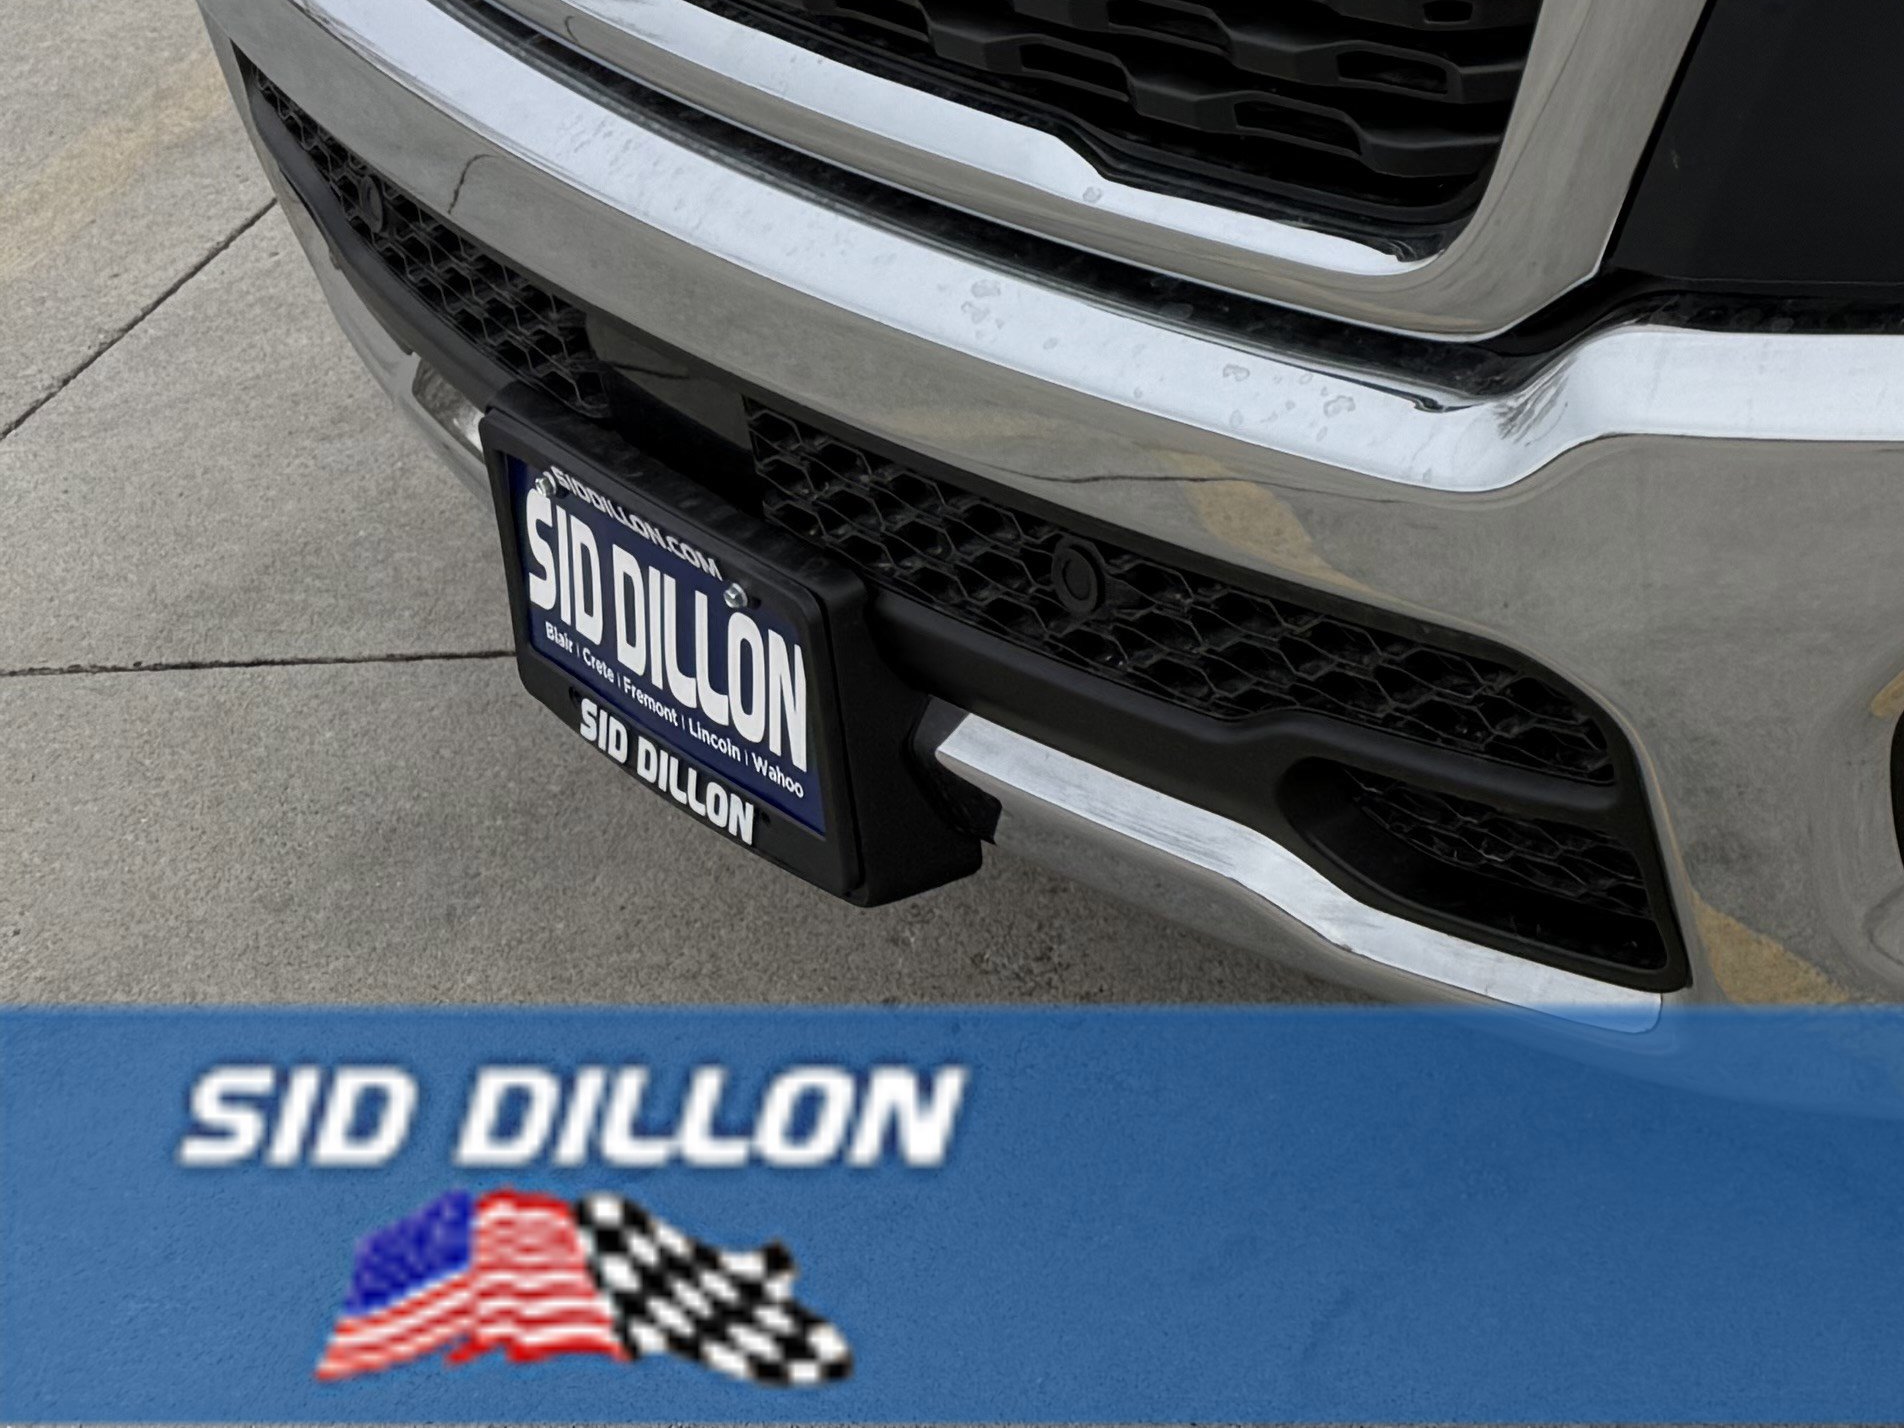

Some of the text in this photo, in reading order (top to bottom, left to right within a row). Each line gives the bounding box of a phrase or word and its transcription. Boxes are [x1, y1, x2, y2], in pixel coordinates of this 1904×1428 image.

[550, 465, 723, 582] SIDDILLON.COM
[526, 487, 807, 773] SID DILLON
[545, 621, 805, 799] Blair Crete Fremont Lincoln Wahoo
[579, 697, 754, 845] SID DILLON
